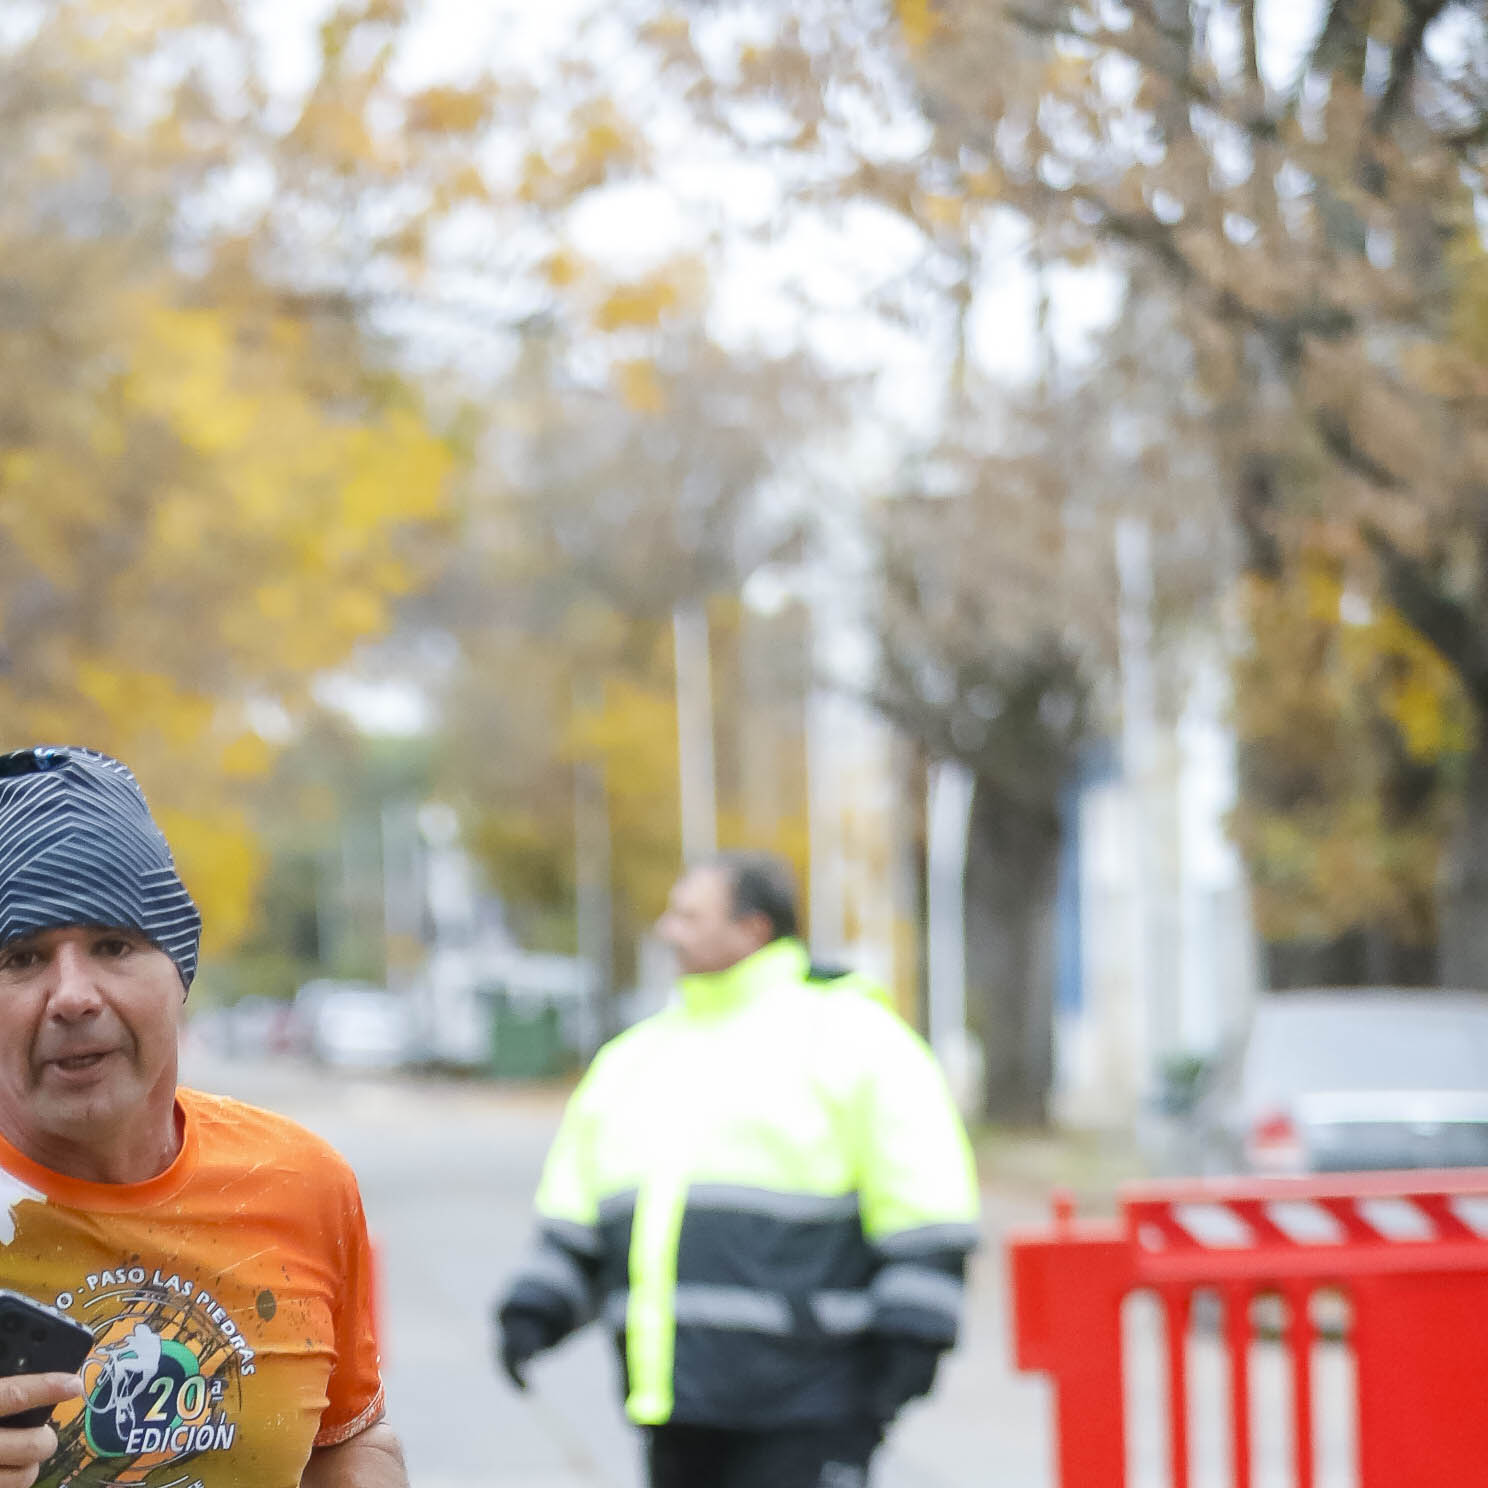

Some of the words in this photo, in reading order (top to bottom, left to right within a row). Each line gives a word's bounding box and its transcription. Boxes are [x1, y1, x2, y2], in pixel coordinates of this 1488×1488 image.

[85, 1266, 146, 1292] PASO
[151, 1269, 194, 1297] LAS
[195, 1290, 257, 1377] PIEDRAS
